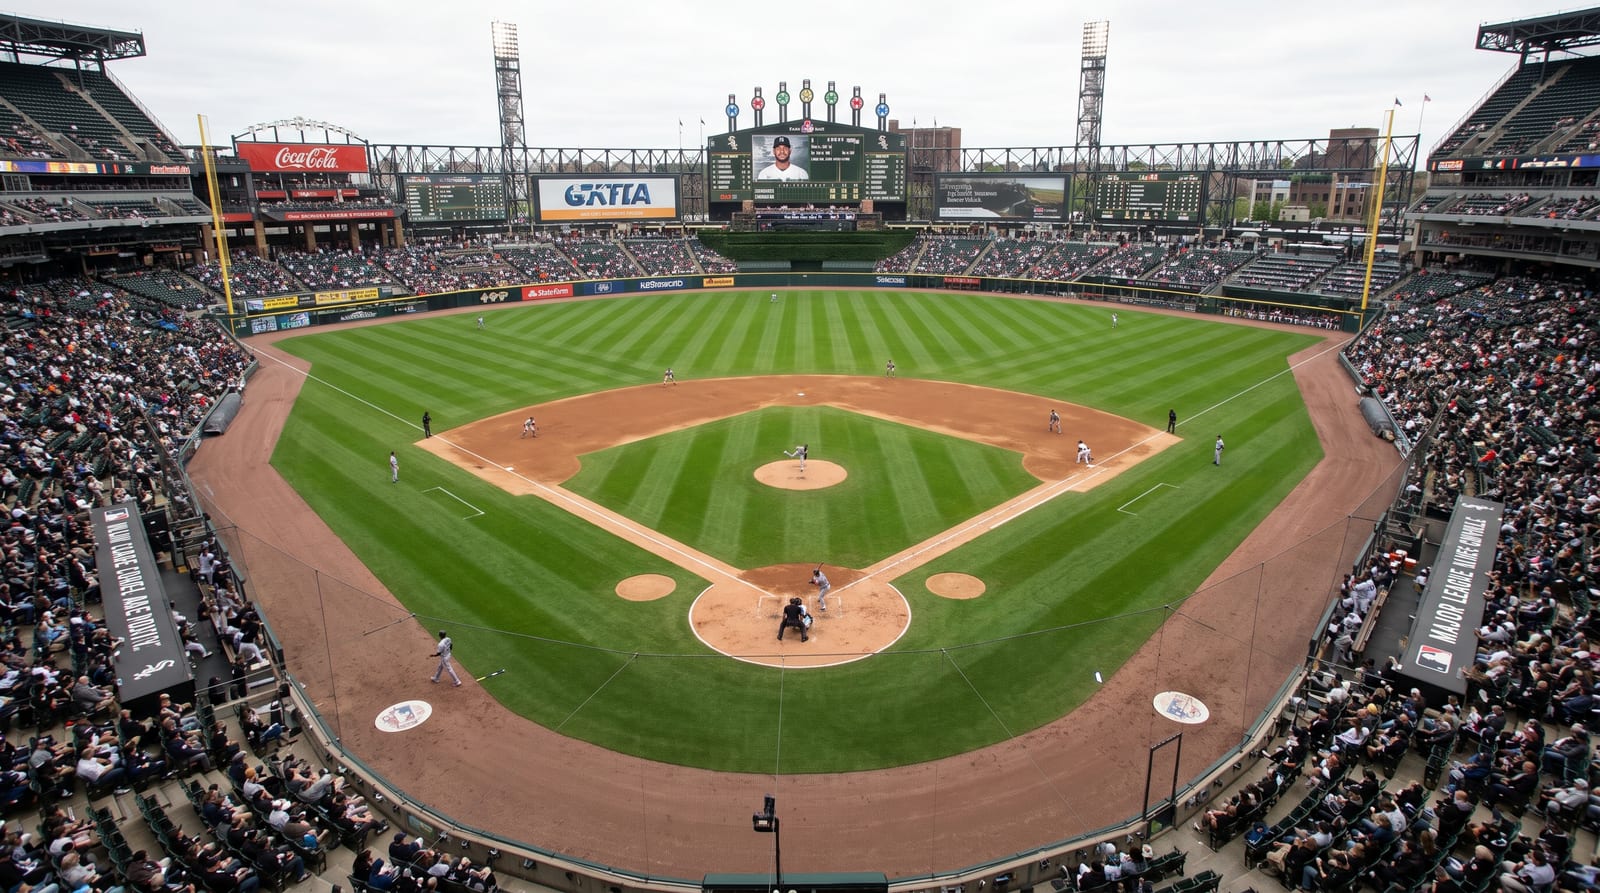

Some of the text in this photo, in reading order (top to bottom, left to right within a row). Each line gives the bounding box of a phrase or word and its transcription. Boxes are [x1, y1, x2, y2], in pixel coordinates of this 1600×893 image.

[275, 147, 339, 169] Coca-Cola
[1441, 567, 1475, 605] LEAGUE
[1429, 604, 1465, 645] MAJOR
